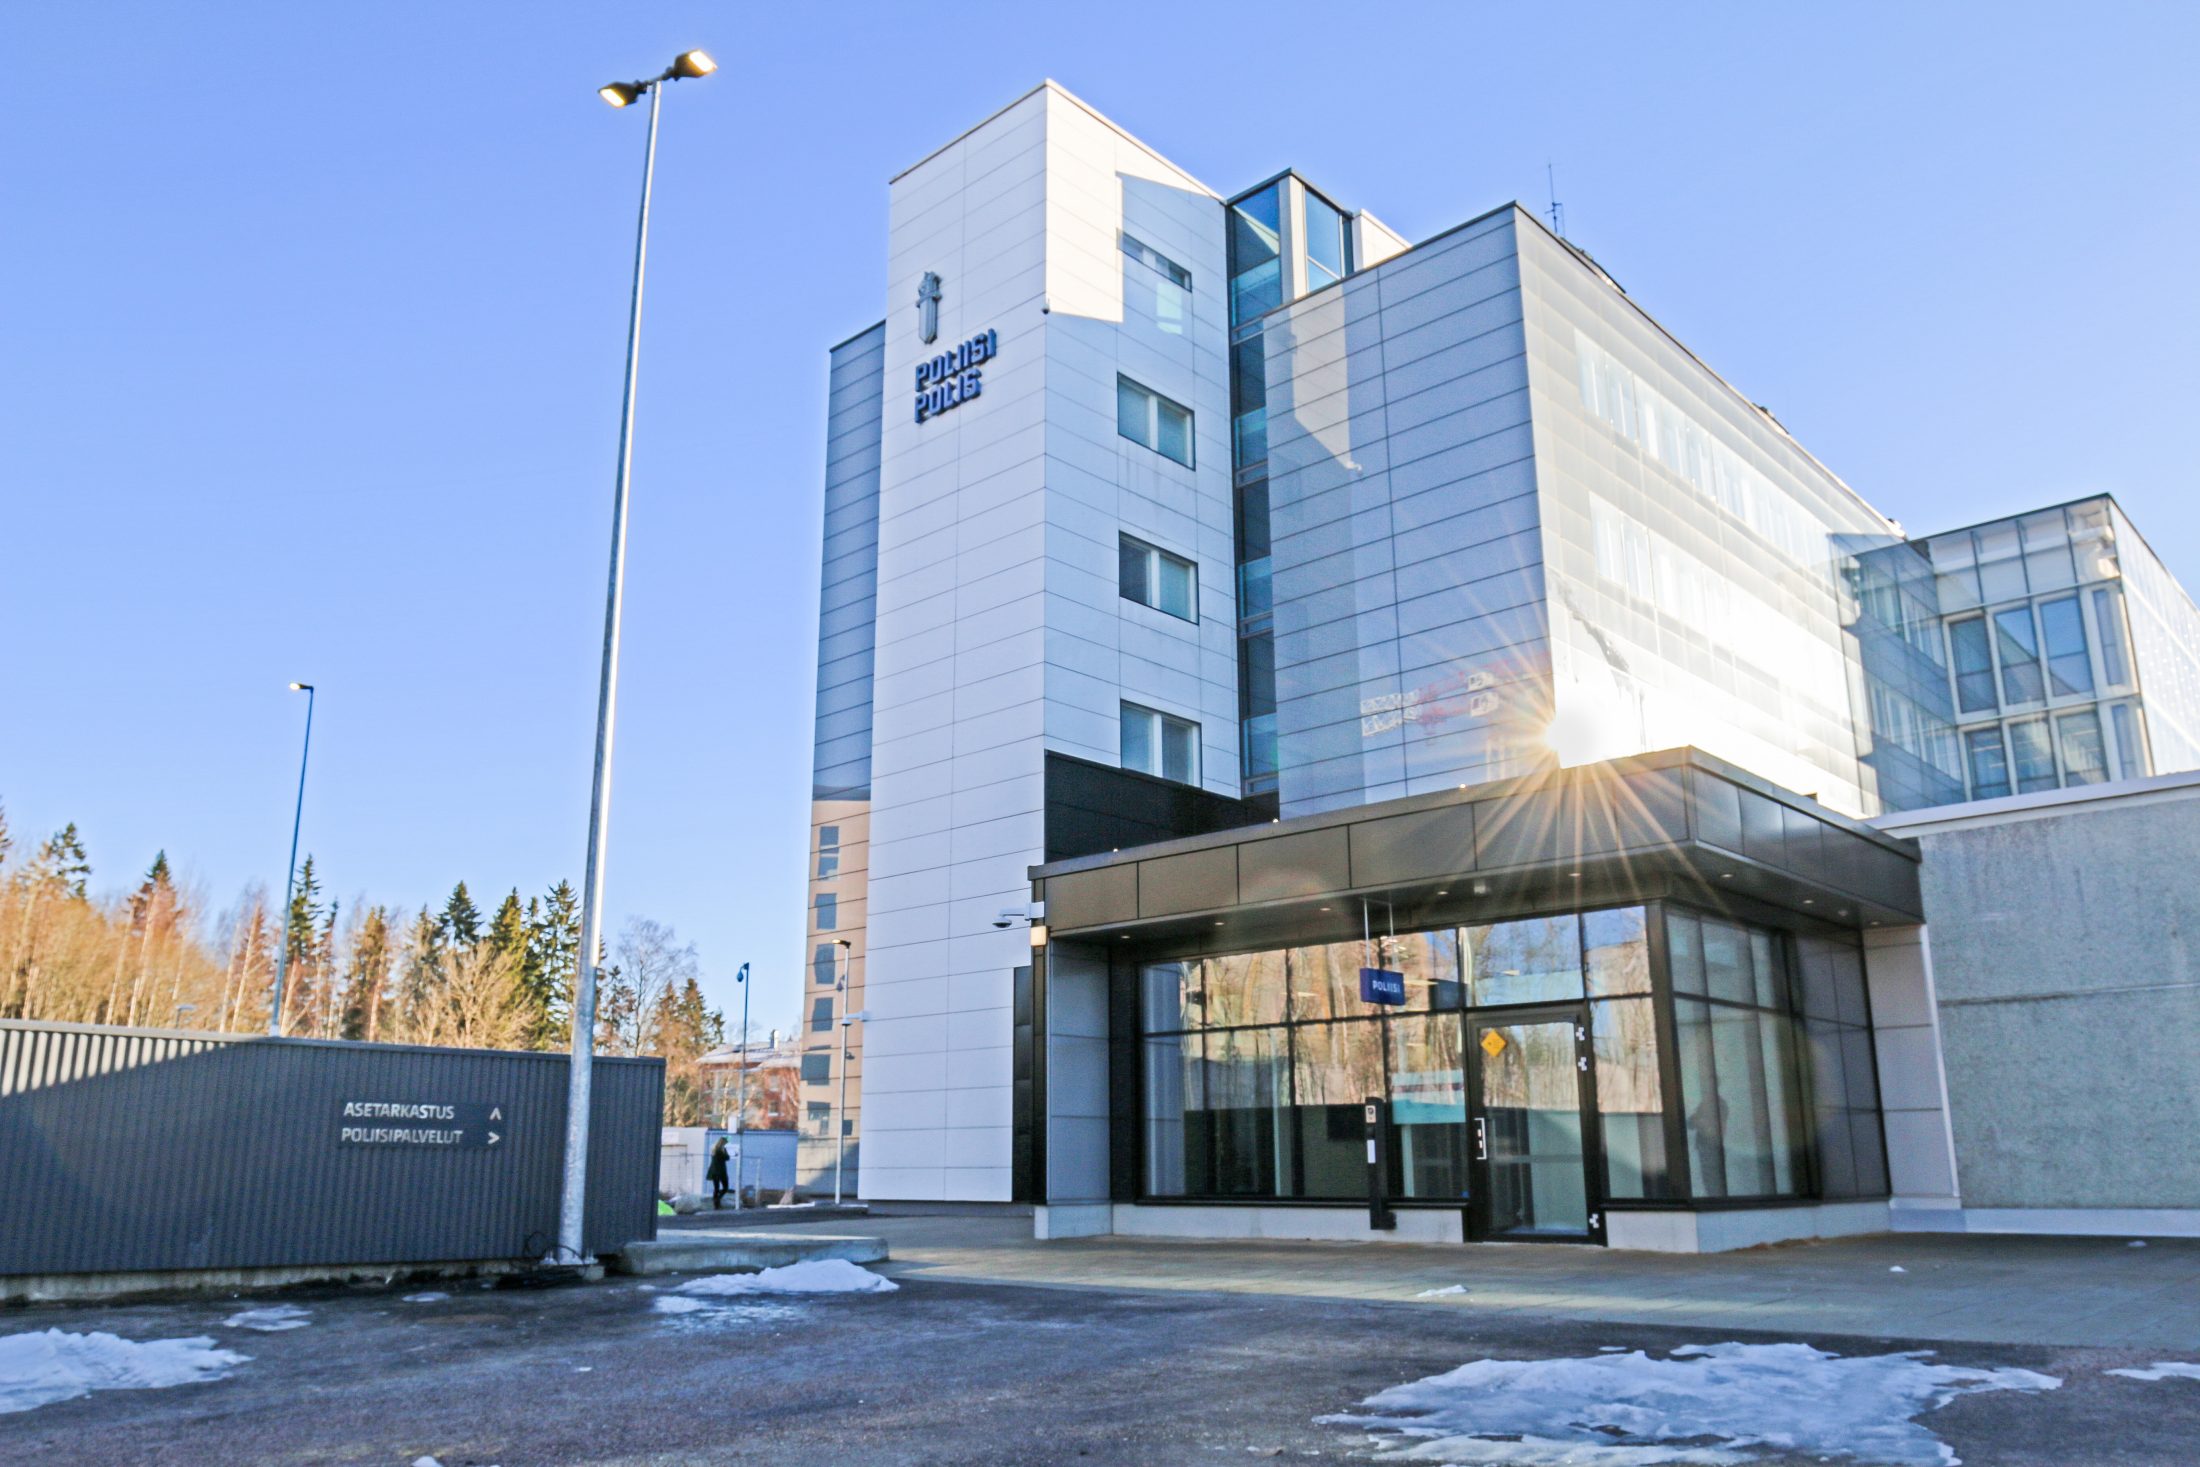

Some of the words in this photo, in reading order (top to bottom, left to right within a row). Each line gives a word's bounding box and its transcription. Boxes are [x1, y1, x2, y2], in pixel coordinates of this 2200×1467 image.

[916, 328, 997, 392] POLIISI
[915, 368, 982, 424] POLIS
[1372, 980, 1401, 993] POLIISI
[343, 1102, 455, 1120] ASETARKASTUS
[340, 1127, 463, 1144] POLIISIPALVELUT
